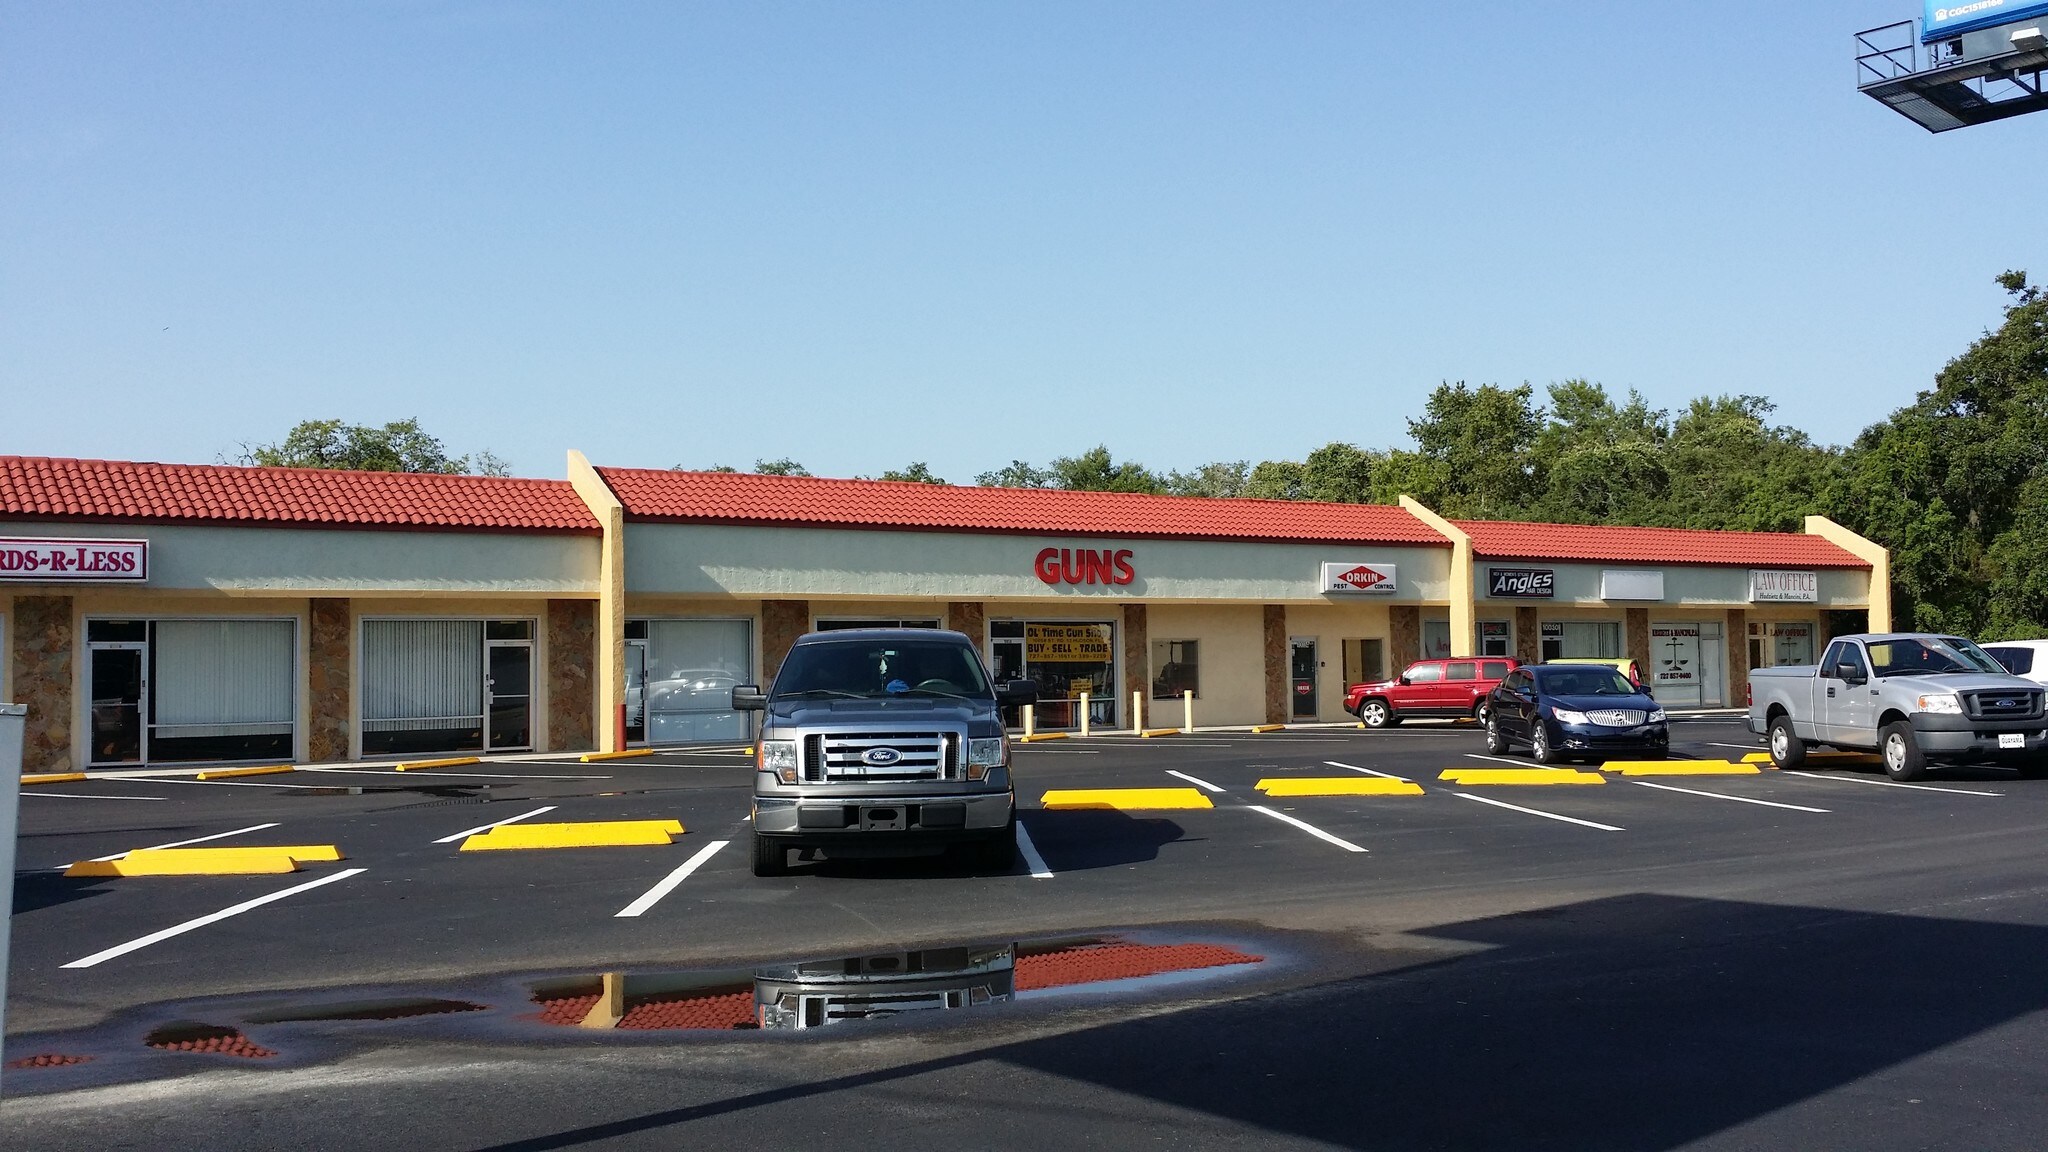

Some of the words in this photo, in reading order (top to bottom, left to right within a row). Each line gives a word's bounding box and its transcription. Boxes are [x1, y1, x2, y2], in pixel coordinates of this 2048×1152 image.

[1034, 547, 1135, 586] GUNS
[1346, 572, 1378, 583] ORKIN
[1754, 572, 1777, 591] LAW
[1780, 572, 1815, 592] OFFICE
[1042, 628, 1064, 638] Time
[1066, 628, 1083, 638] Gun
[1785, 628, 1808, 637] OFFICE
[1027, 643, 1045, 653] BUY
[1052, 643, 1072, 653] SELL
[1080, 643, 1108, 653] TRADE
[872, 751, 891, 761] Ford
